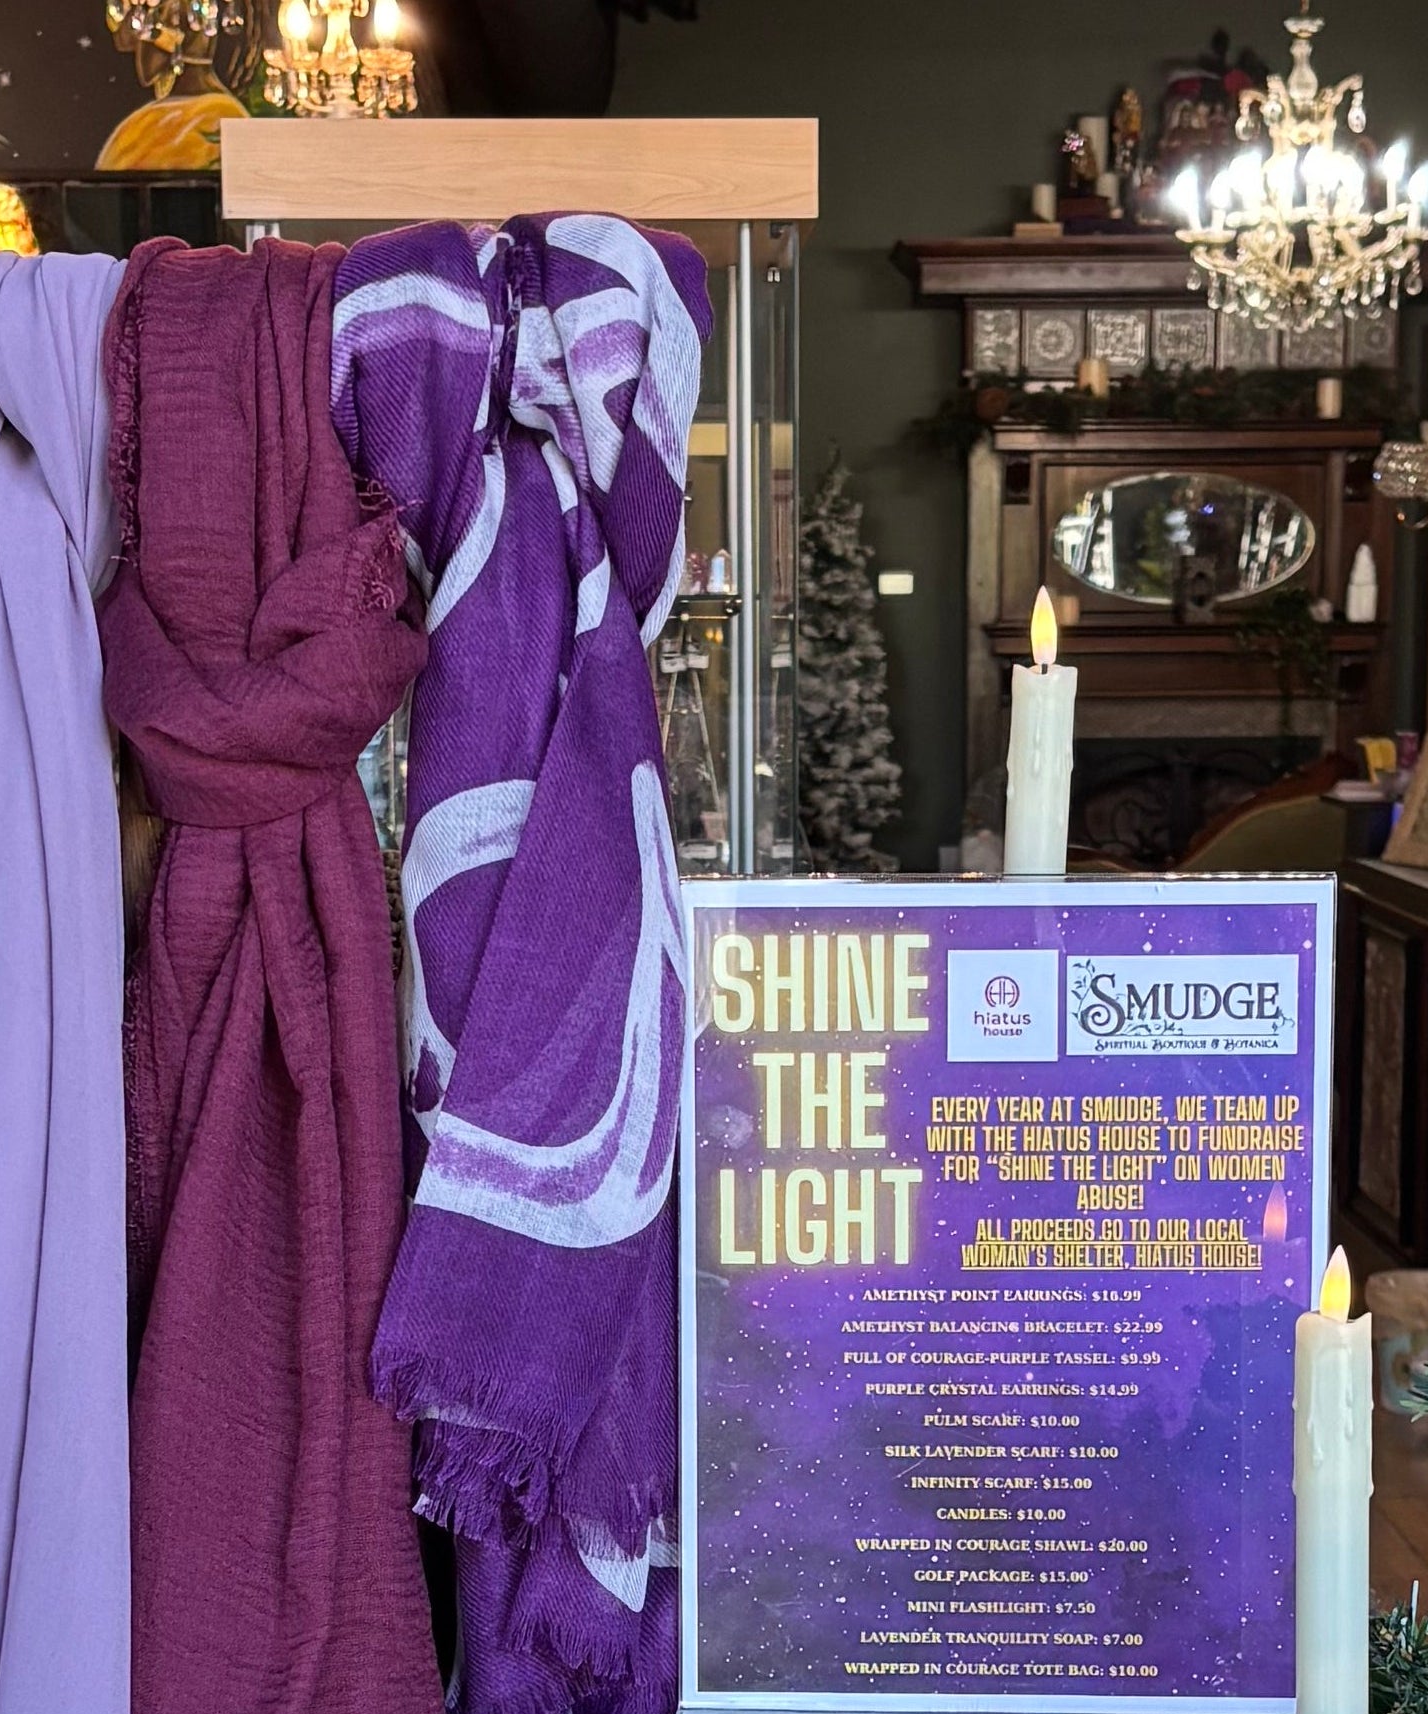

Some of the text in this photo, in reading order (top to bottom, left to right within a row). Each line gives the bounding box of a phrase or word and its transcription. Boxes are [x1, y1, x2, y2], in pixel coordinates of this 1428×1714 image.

[712, 933, 930, 1033] SHINE
[1078, 973, 1280, 1036] SMUDGE
[974, 1011, 1031, 1027] hiatus
[983, 1026, 1022, 1036] house
[1224, 1038, 1279, 1051] BOTANICA
[752, 1052, 886, 1149] THE
[932, 1096, 1300, 1124] EVERY YEAR AT SMUDGE, WE TEAM UP
[926, 1126, 1304, 1152] WITH THE HIATUS HOUSE TO FUNDRAISE
[944, 1155, 980, 1180] FOR
[1062, 1155, 1096, 1180] THE
[1174, 1155, 1201, 1180] ON
[1209, 1155, 1285, 1180] WOMEN
[1077, 1184, 1144, 1210] ABUSE!
[719, 1168, 923, 1265] LIGHT
[976, 1219, 1247, 1241] ALL PROCEEDS GO TO OUR LOCAL
[1053, 1245, 1130, 1269] SHELTER,
[1136, 1245, 1195, 1267] HIATUS
[1202, 1245, 1262, 1267] HOUSE!
[863, 1290, 946, 1301] AMETHYST
[952, 1290, 1000, 1301] POINT
[1004, 1290, 1088, 1301] EARRINGS:
[841, 1321, 1164, 1334] AMETHYST BALANCING BRACELET: $22.99
[843, 1352, 1161, 1365] FULL OF COURAGE-PURPLE TASSEL: $9.99
[865, 1384, 1139, 1396] PURPLE CRYSTAL EARRINGS: $14.99
[972, 1415, 1026, 1427] SCARF:
[1031, 1415, 1080, 1427] $10.00
[885, 1446, 1118, 1458] SILK LAVENDER SCARF: $10.00
[911, 1478, 1092, 1490] INFINITY SCARF: $15.00
[937, 1509, 1066, 1520] CANDLES: $10.00
[856, 1539, 1148, 1553] WRAPPED IN COURAGE SHAWL: $20.00
[914, 1570, 1089, 1583] GOLF PACKAGE: $15.00
[908, 1601, 1096, 1614] MINI FLASHLIGHT: $7.50
[860, 1632, 1143, 1646] LAVENDER TRANQUILITY SOAP: $7.00
[845, 1663, 1158, 1677] WRAPPED IN COURAGE TOTE BAG: $10.00
